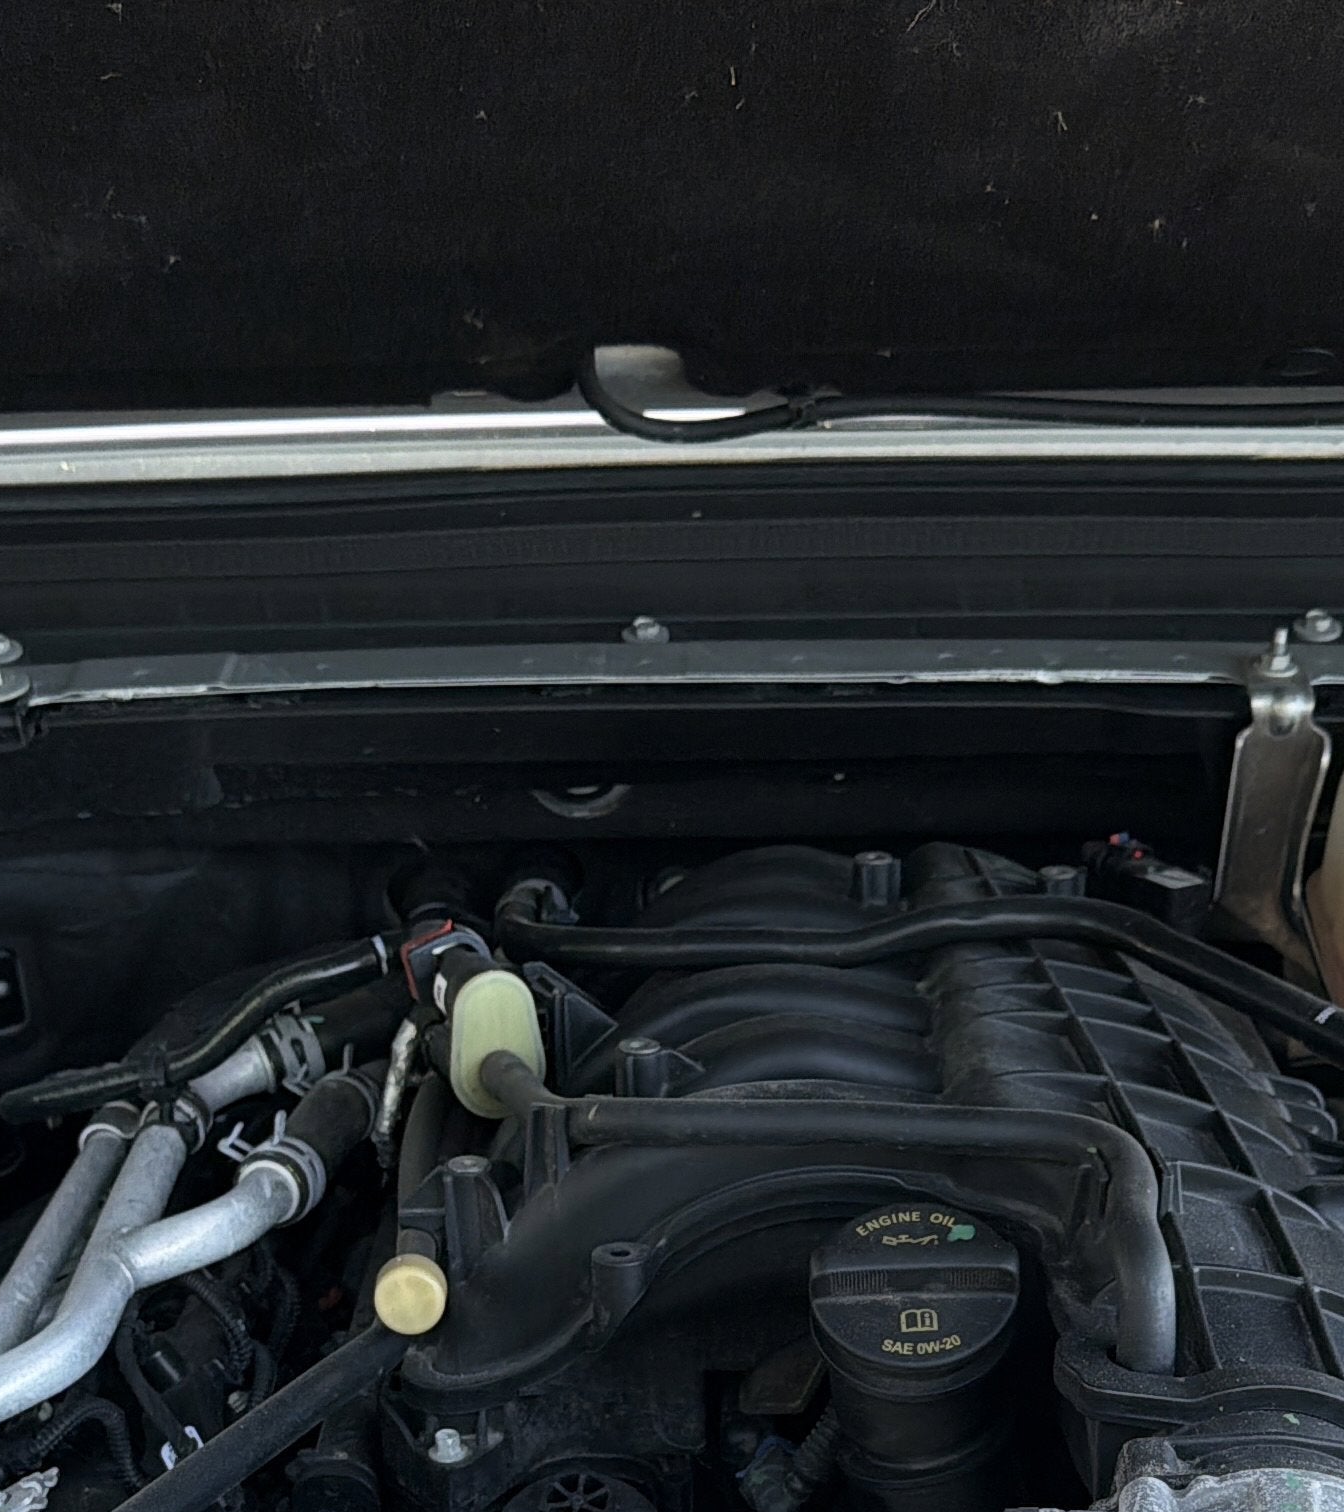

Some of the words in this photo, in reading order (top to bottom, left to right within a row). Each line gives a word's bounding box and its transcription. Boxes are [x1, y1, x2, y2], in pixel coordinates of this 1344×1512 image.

[855, 1211, 921, 1238] ENGINE
[929, 1212, 957, 1228] OIL
[881, 1338, 914, 1355] SAE
[916, 1334, 962, 1354] 0W-20
